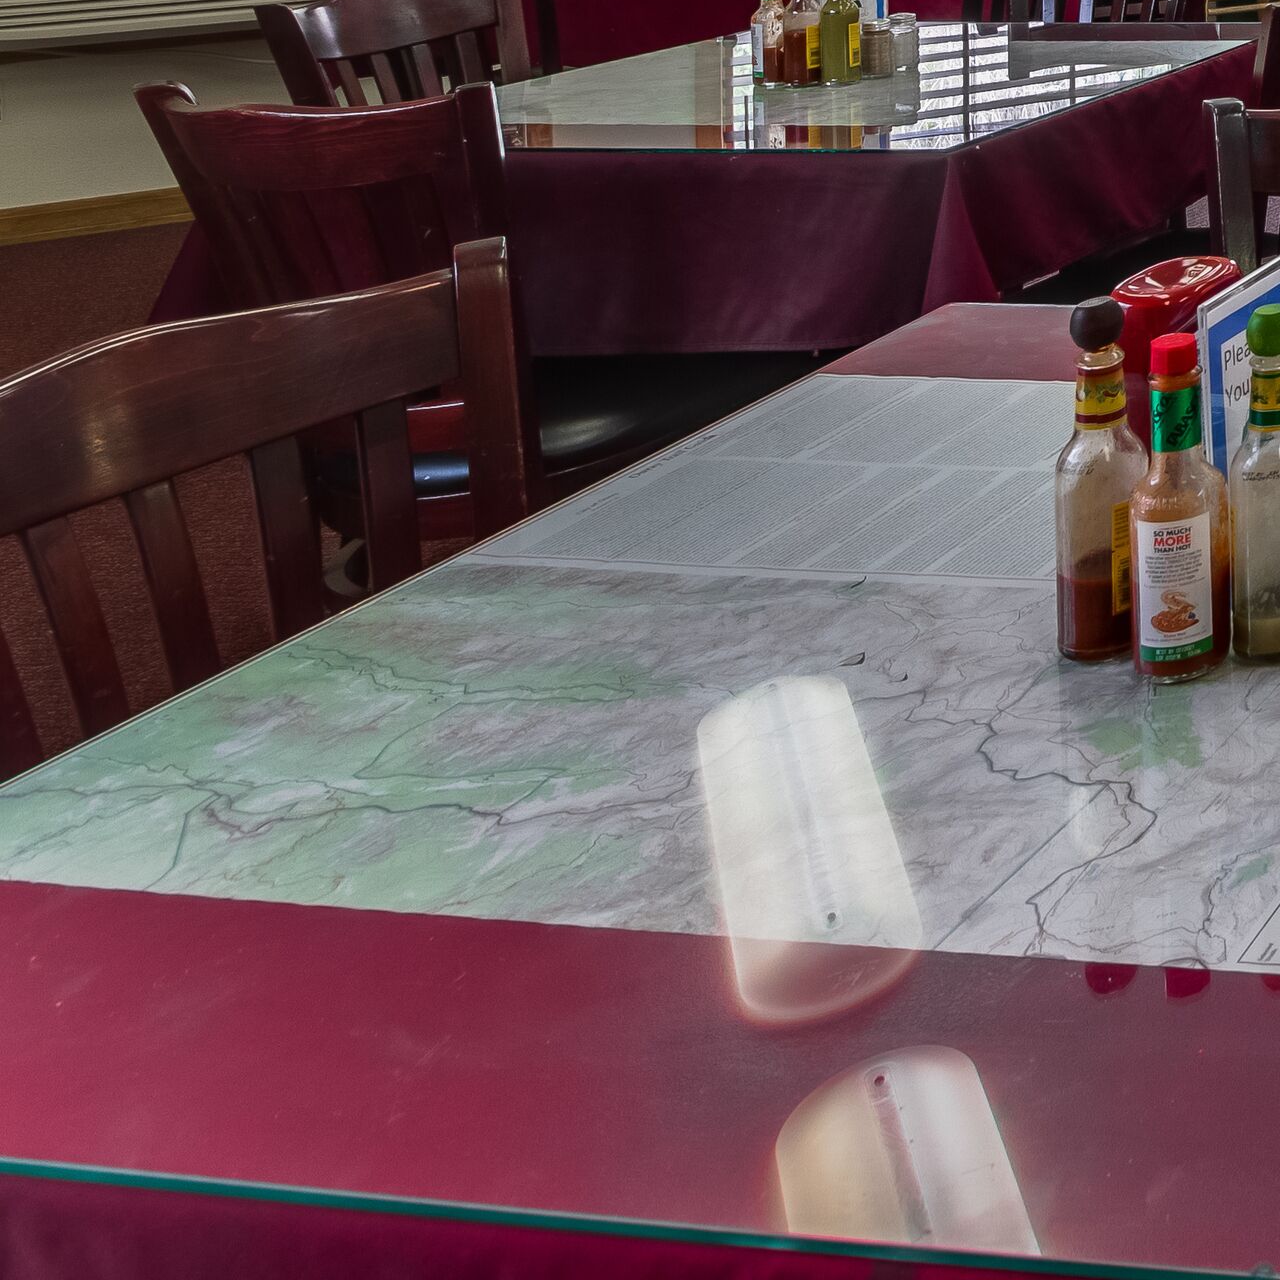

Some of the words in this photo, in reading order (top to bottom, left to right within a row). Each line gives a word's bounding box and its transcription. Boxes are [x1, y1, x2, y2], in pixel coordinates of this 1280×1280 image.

[1223, 342, 1251, 371] Plea
[1225, 378, 1250, 407] You
[1153, 530, 1165, 538] SO
[1165, 526, 1191, 537] MUCH
[1153, 533, 1191, 547] MORE
[1153, 546, 1175, 554] THAN
[1175, 544, 1191, 552] HOT
